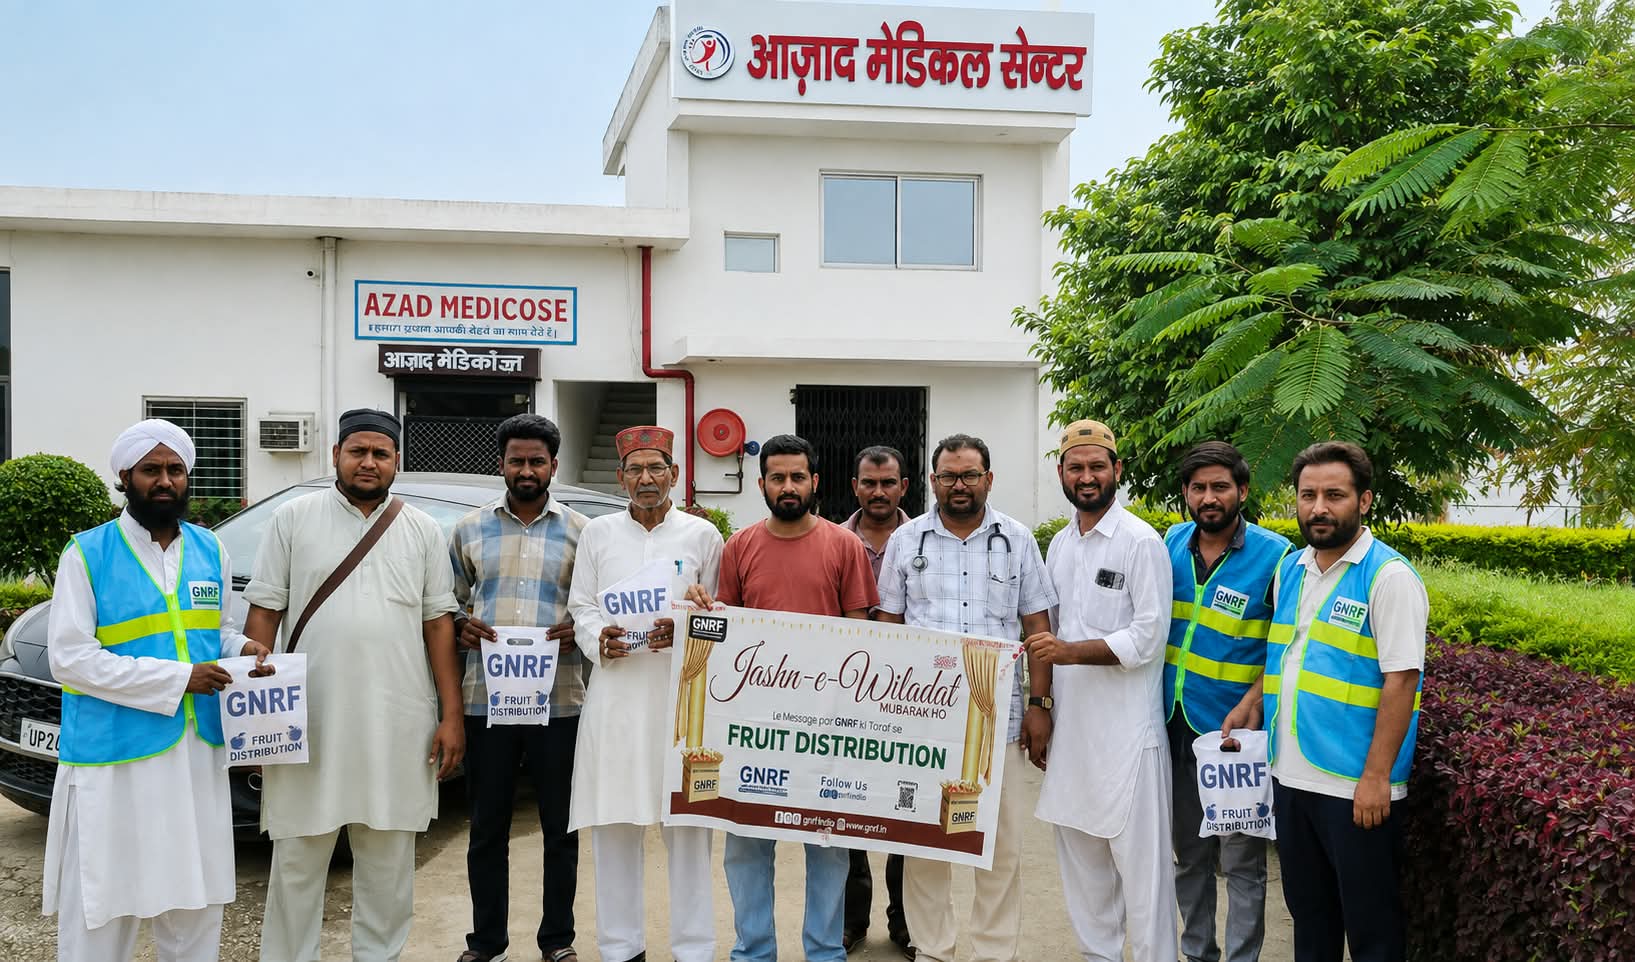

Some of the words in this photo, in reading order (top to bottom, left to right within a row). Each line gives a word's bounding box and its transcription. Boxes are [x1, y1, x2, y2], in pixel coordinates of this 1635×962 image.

[747, 33, 859, 96] आज़ाद
[866, 20, 994, 88] मेडिकल
[364, 293, 432, 317] AZAD
[441, 295, 567, 322] MEDICOSE
[384, 351, 435, 371] आज़ाद
[192, 586, 218, 597] GNRF
[1216, 590, 1246, 609] GNRF
[604, 588, 666, 615] GNRF
[1333, 600, 1366, 618] GNRF
[693, 618, 724, 632] GNRF
[626, 631, 649, 640] FRUI
[487, 653, 553, 678] GNRF
[226, 685, 301, 717] GNRF
[504, 696, 532, 705] FRUIT
[490, 705, 547, 716] DISTRIBUTION
[879, 702, 929, 717] MUBARAK
[931, 707, 947, 720] HO
[834, 717, 858, 728] GNRF
[252, 732, 282, 746] FRUIT
[727, 723, 791, 751] FRUIT
[795, 731, 947, 769] DISTRIBUTION
[230, 741, 303, 761] DISTRIBUTION
[740, 765, 789, 786] GNRF
[821, 776, 852, 788] Follow
[855, 781, 868, 791] Us
[1200, 762, 1266, 789] GNRF
[694, 780, 717, 790] GNRF
[952, 811, 976, 822] GNRF
[1222, 808, 1252, 820] FRUIT
[1206, 817, 1271, 832] DISTRIBUTION
